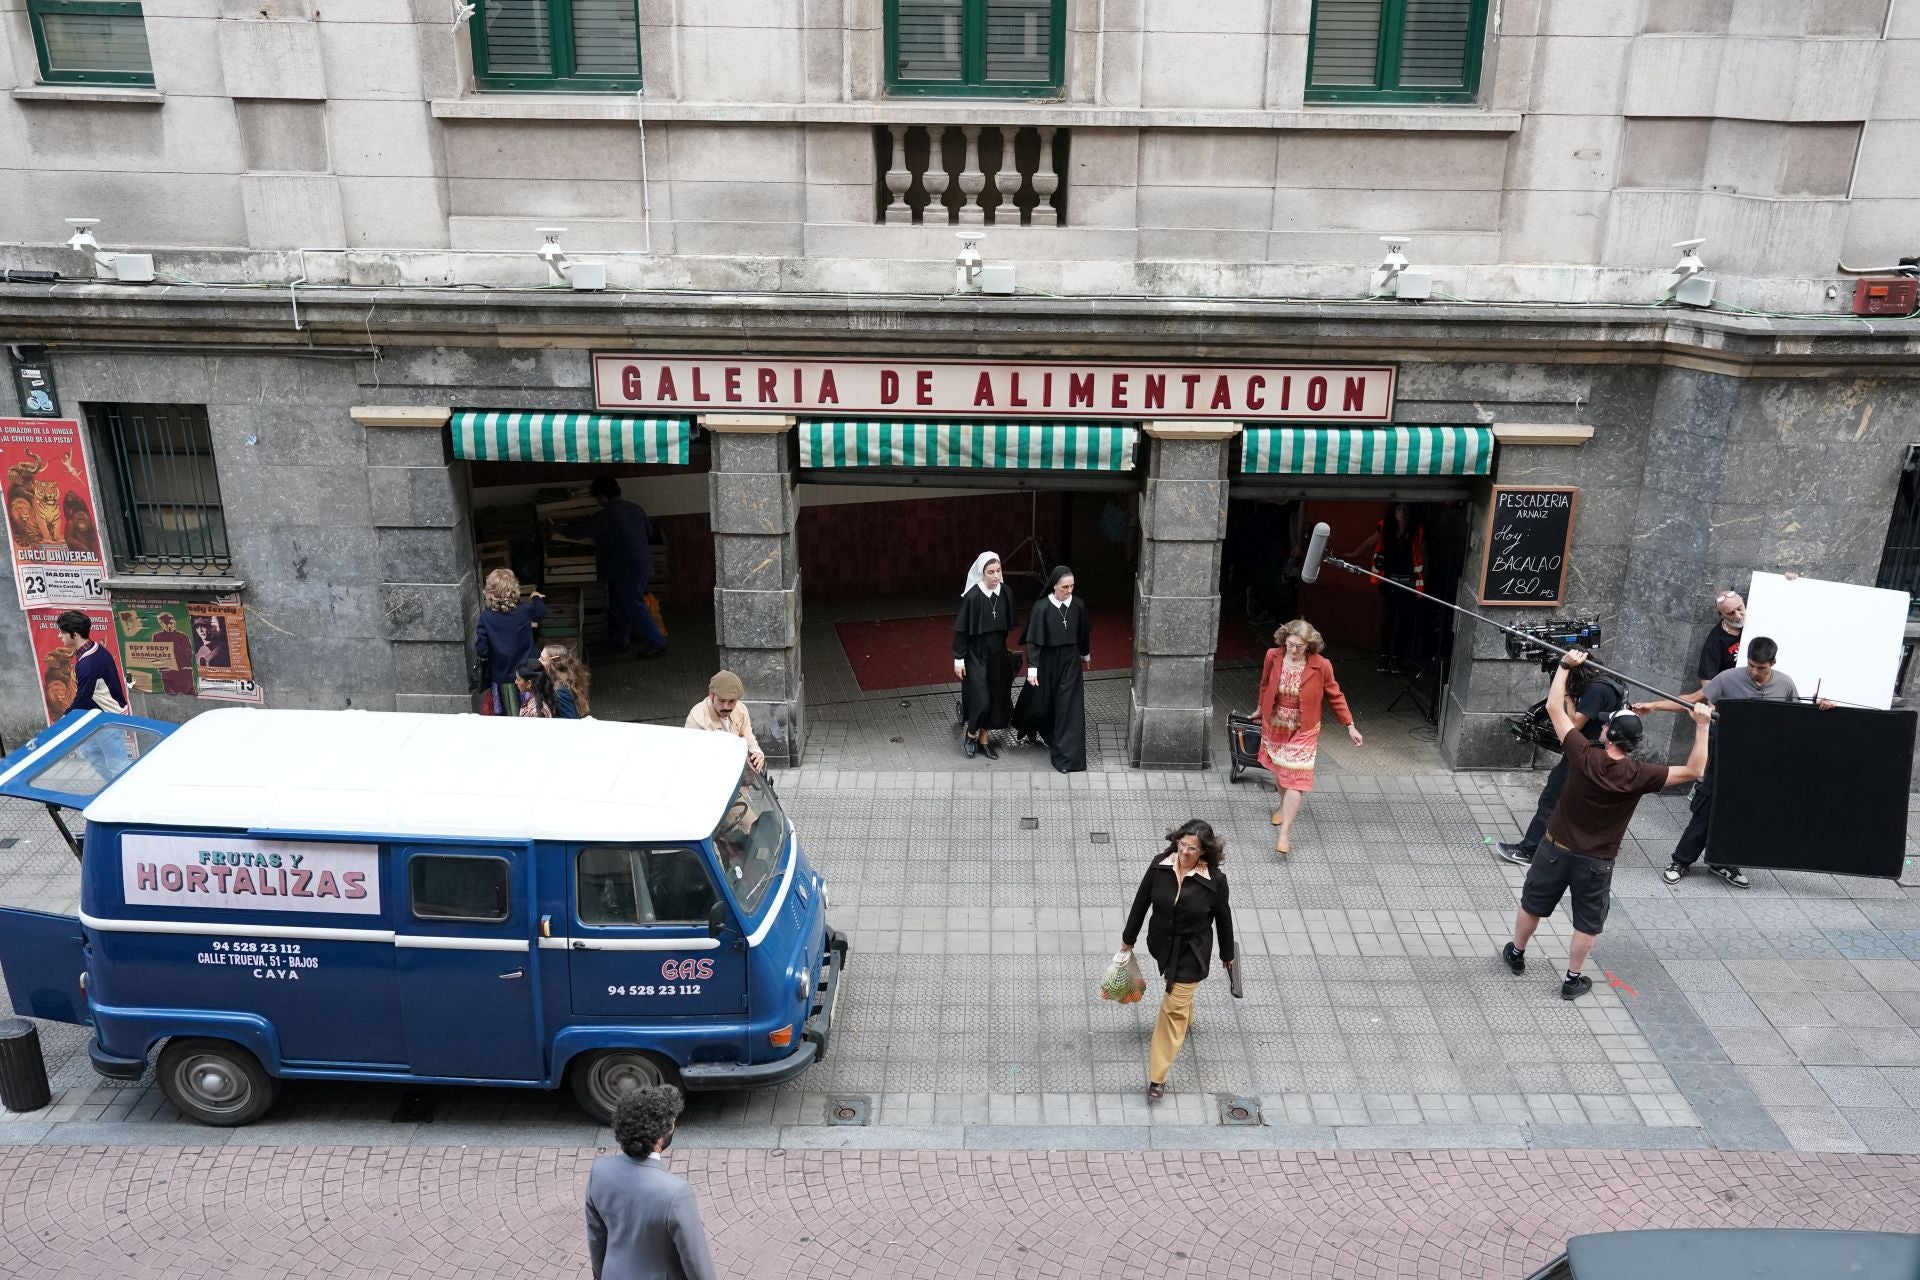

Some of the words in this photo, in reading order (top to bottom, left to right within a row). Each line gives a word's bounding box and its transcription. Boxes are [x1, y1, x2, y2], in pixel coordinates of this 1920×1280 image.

[621, 365, 839, 403] GALERIA
[880, 369, 933, 406] DE
[973, 371, 1366, 412] ALIMENTACION
[1499, 493, 1569, 508] PESCADERIA
[18, 550, 46, 560] CIRCO
[48, 550, 99, 562] UNIVERSAL
[1492, 555, 1561, 573] BACALAO
[25, 576, 46, 594] 23
[85, 577, 103, 596] 15
[1499, 577, 1540, 595] 180
[198, 850, 283, 868] FRUTAS
[289, 854, 304, 869] Y
[137, 862, 368, 900] HORTALIZAS
[212, 941, 230, 951] 94
[233, 942, 257, 952] 528
[260, 943, 277, 953] 23
[280, 944, 301, 954] 112
[197, 952, 226, 965] CALLE
[228, 954, 268, 967] TRUEVA,
[269, 956, 281, 967] 51
[288, 956, 319, 968] BAJOS
[253, 968, 299, 980] CAYA
[661, 958, 715, 981] GAS
[607, 985, 626, 996] 94
[628, 985, 655, 996] 528
[658, 985, 676, 995] 23
[679, 985, 701, 995] 112
